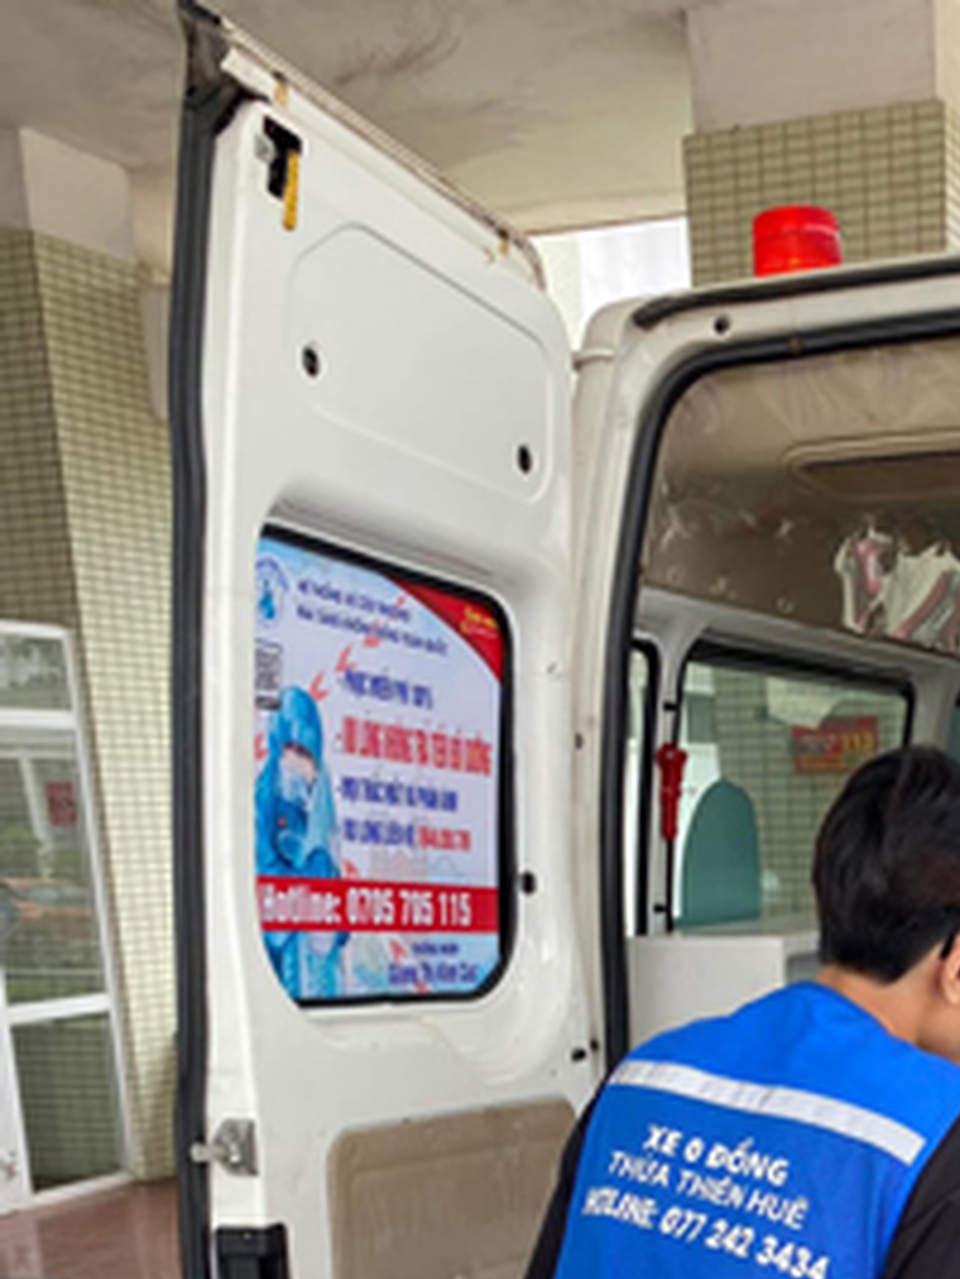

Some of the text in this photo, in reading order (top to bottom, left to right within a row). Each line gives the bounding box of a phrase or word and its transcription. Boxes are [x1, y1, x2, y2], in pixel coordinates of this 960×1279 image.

[643, 1123, 683, 1157] XE
[658, 1205, 708, 1244] 077
[704, 1218, 755, 1259] 242
